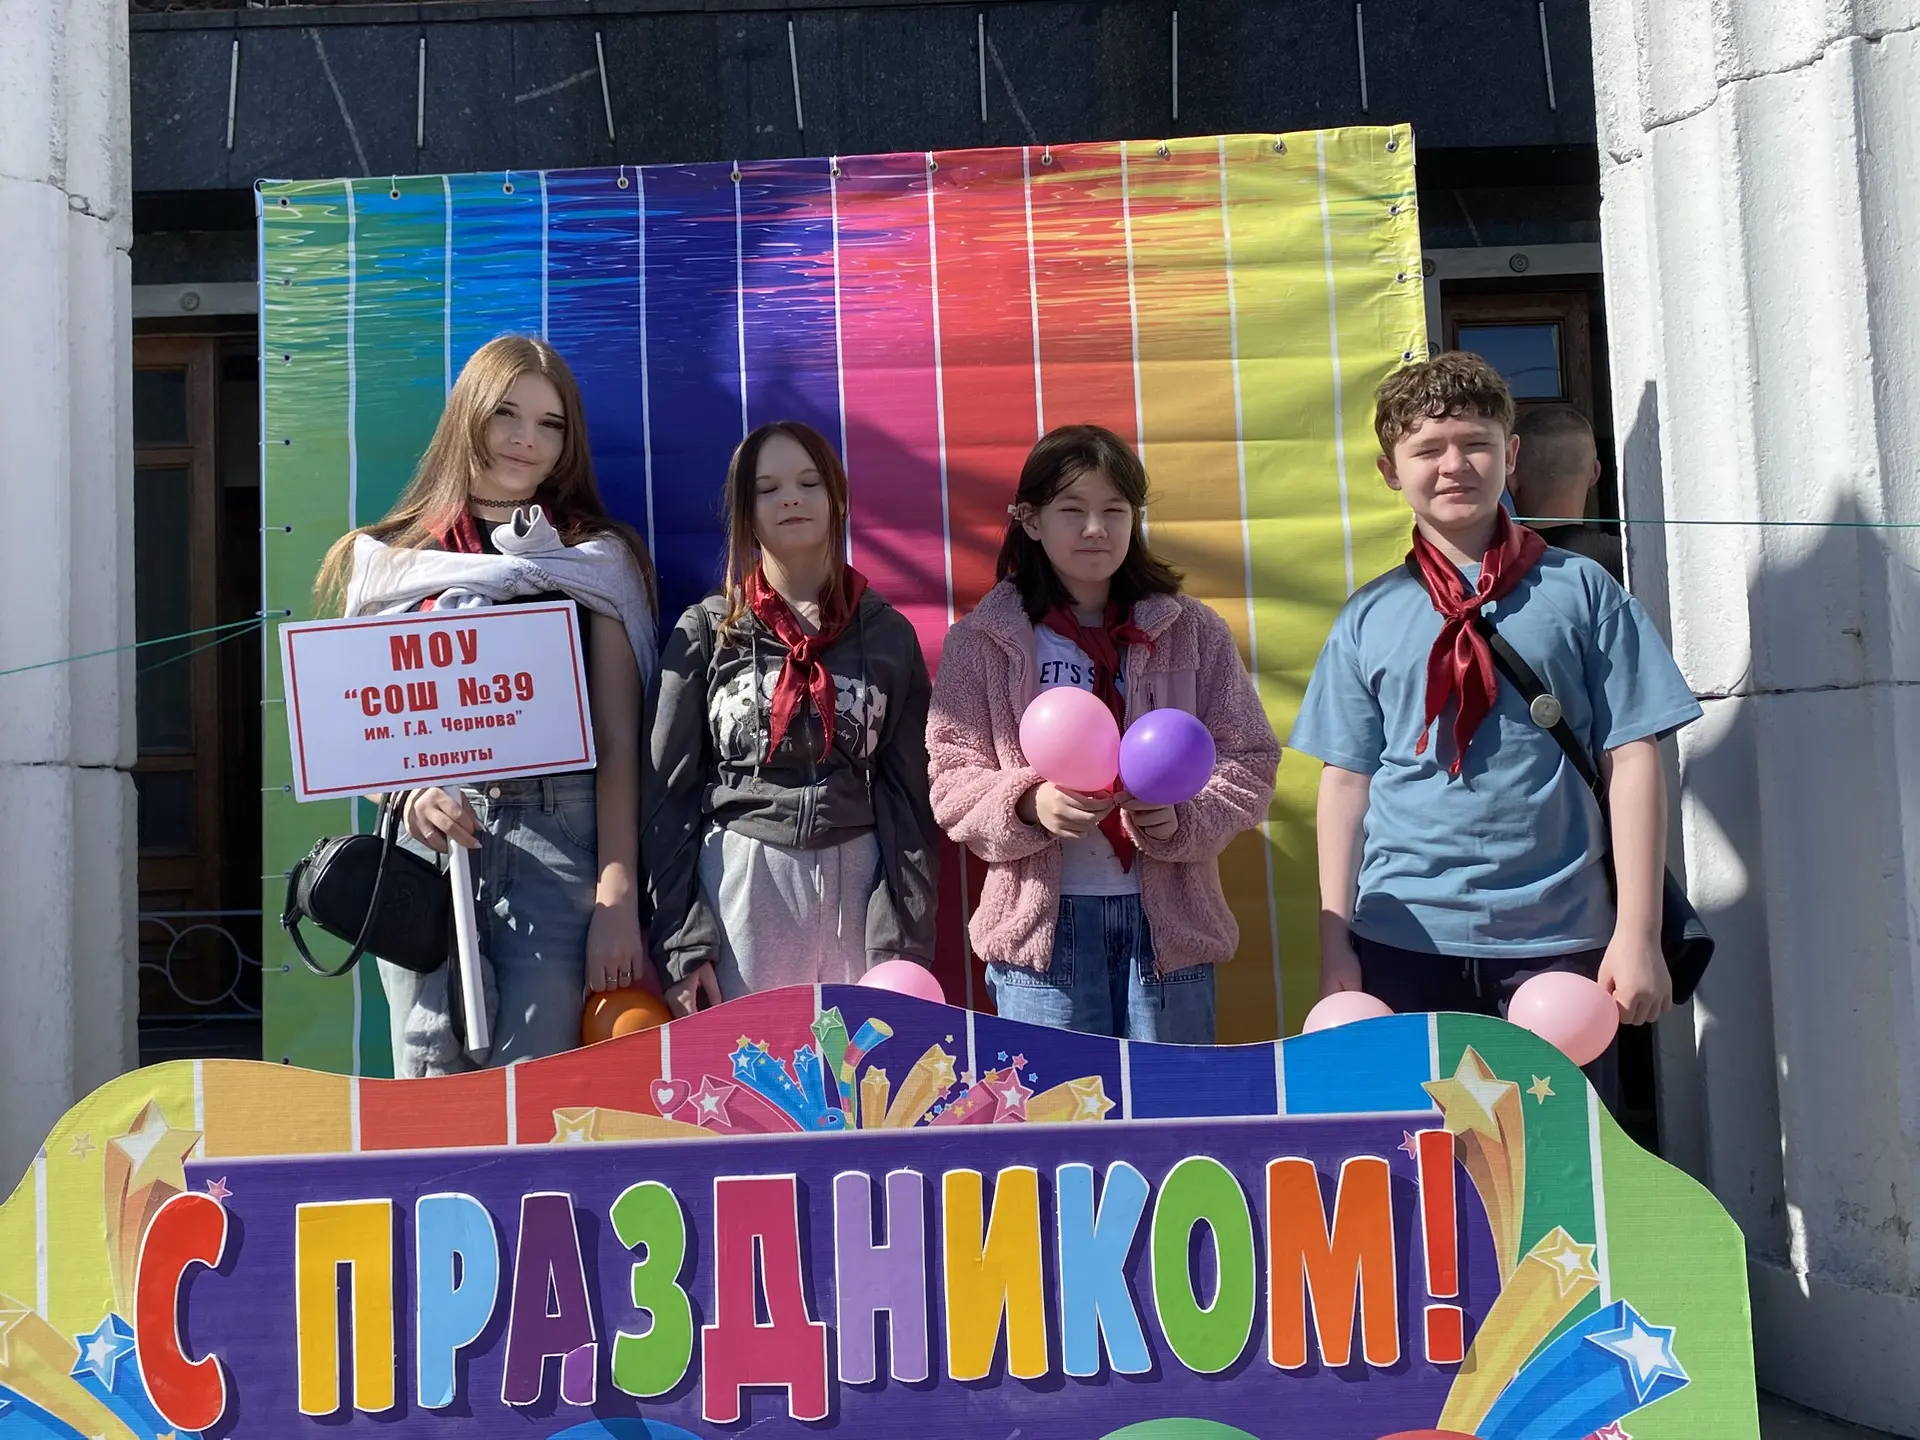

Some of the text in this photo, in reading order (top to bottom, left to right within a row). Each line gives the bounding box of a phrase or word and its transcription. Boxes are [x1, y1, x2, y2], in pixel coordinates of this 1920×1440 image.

[389, 628, 478, 671] МОУ
[1040, 661, 1081, 684] ET'S
[344, 672, 535, 717] “СОШ №39
[364, 725, 396, 742] им.
[403, 719, 433, 738] Г.А.
[403, 747, 494, 770] г. Воркуты
[133, 1128, 1465, 1432] С ПРАЗДНИКОМ!
